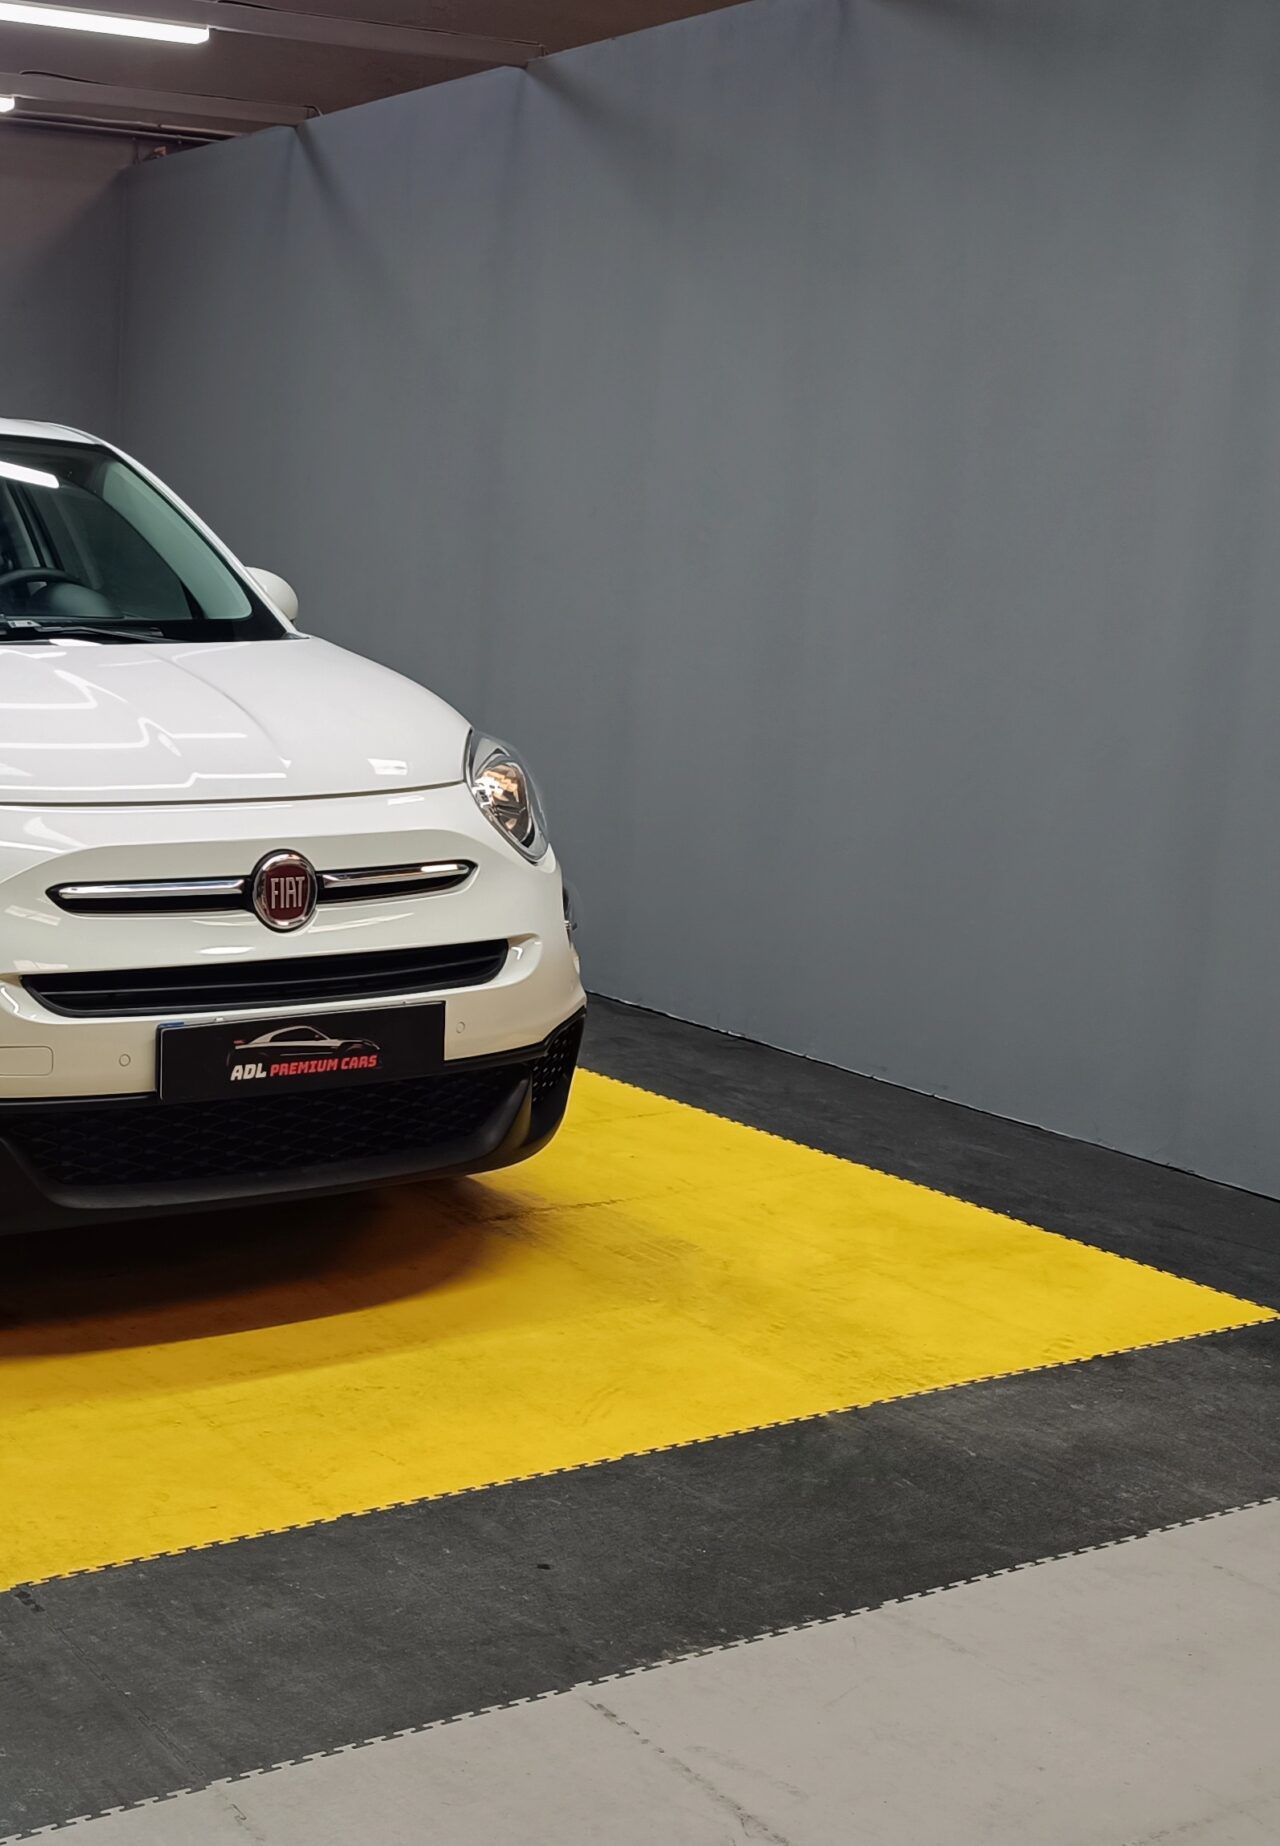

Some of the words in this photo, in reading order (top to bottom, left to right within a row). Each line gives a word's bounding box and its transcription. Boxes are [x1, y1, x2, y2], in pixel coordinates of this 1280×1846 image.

[270, 876, 306, 909] FIAT
[230, 1063, 266, 1082] ADL
[270, 1058, 338, 1077] PREMIUM
[340, 1055, 378, 1071] CARS
